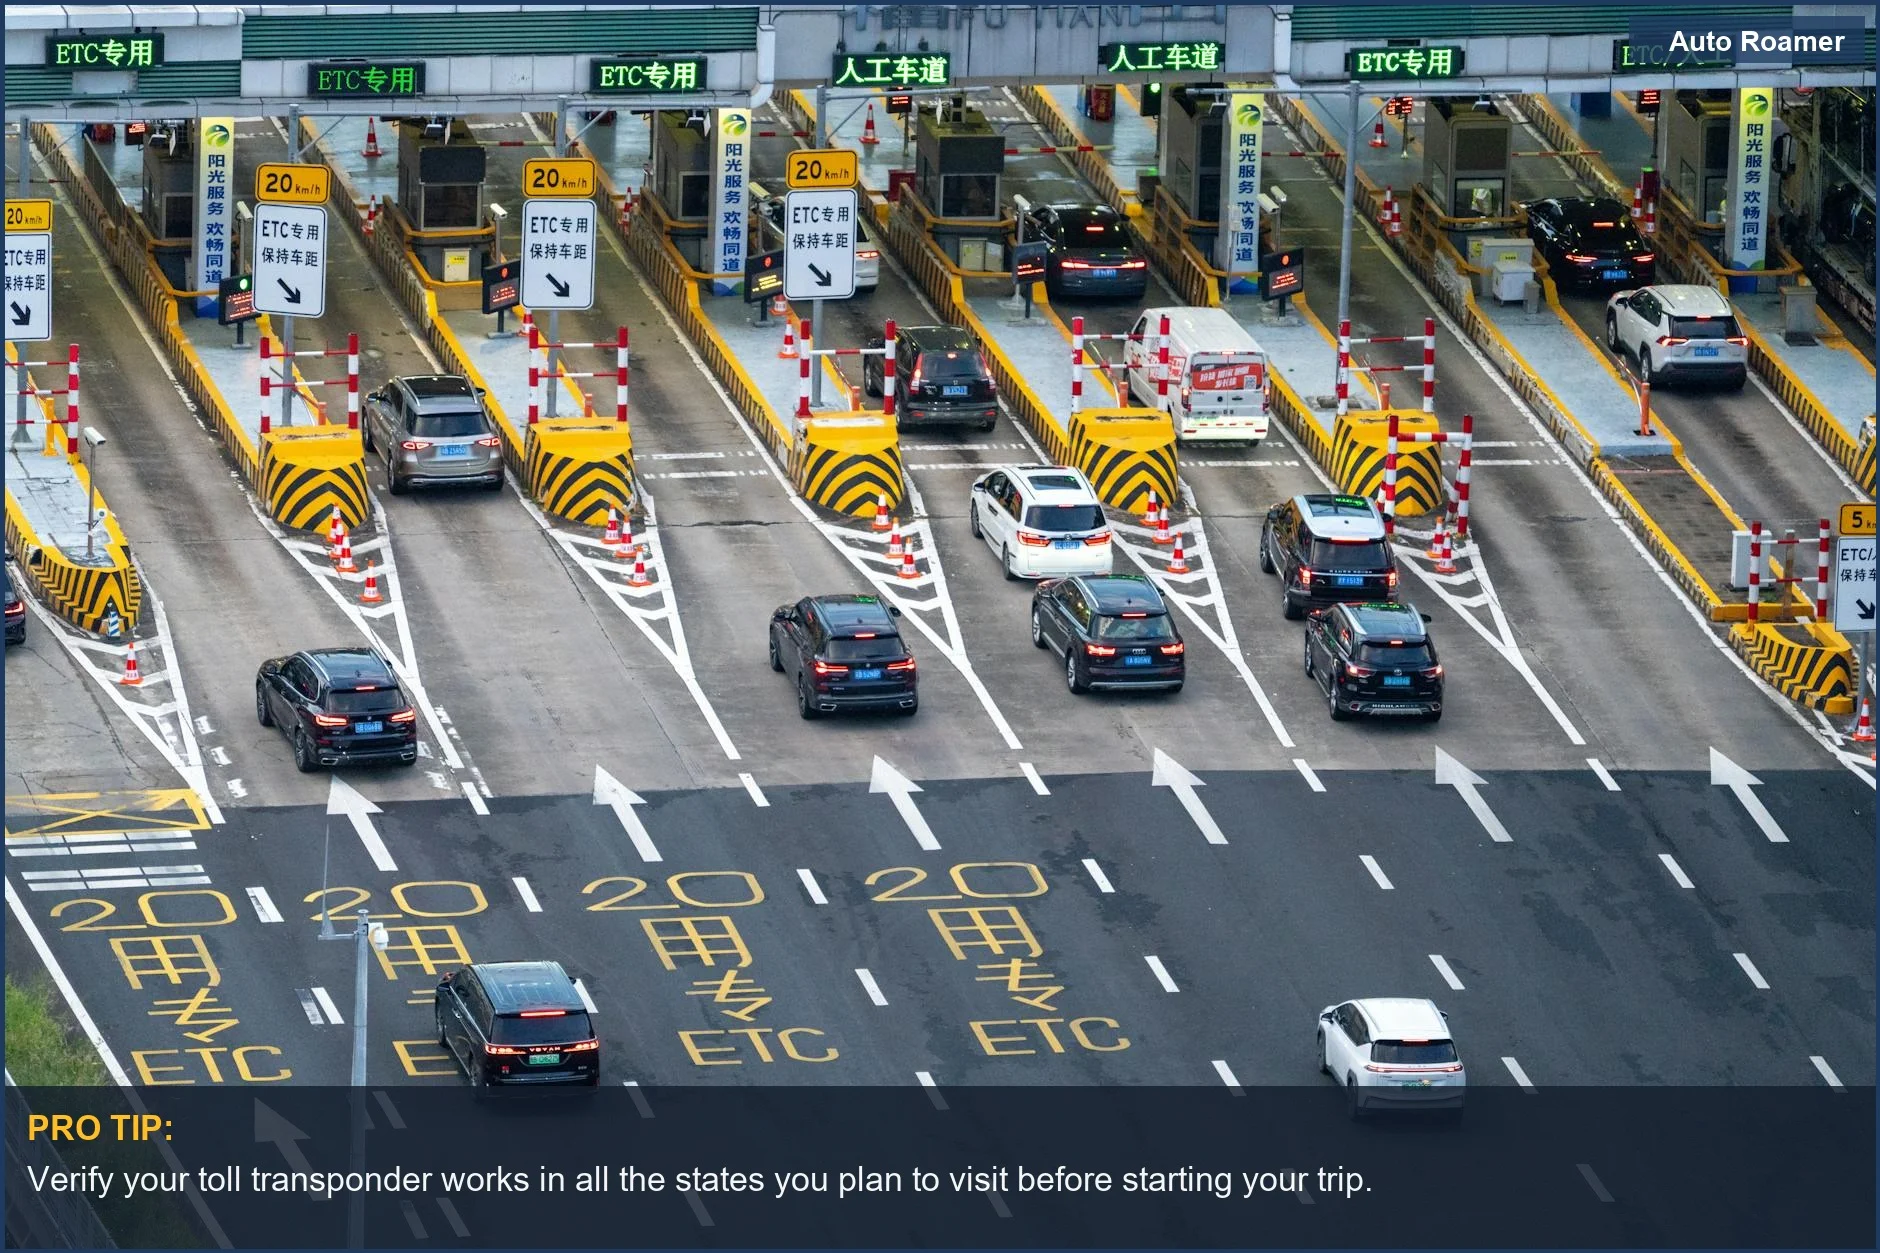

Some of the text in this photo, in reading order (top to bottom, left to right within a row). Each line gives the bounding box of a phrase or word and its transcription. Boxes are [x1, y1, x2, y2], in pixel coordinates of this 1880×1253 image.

[55, 40, 153, 67] ETC专用
[836, 56, 948, 85] 人工车道
[1108, 43, 1219, 73] 人工车道
[1355, 47, 1453, 76] ETC专用
[317, 66, 415, 94] ETC专用
[600, 60, 697, 90] ETC专用
[532, 168, 588, 189] 20 km/h
[795, 159, 850, 181] 20 km/h
[1238, 133, 1257, 195] 阳光服务
[265, 173, 321, 195] 20 km/h
[1740, 123, 1764, 252] 阳光服务 欢畅同道
[7, 207, 43, 225] 20 km/h
[205, 154, 226, 285] 阳光服务 欢畅同道
[531, 216, 588, 234] ETC专用
[721, 143, 743, 273] 阳光服务 欢畅同道
[793, 206, 849, 224] ETC专用
[262, 220, 319, 241] ETC专用
[793, 232, 849, 249] 保持车距
[261, 247, 318, 267] 保持车距
[530, 243, 587, 260] 保持车距
[1851, 510, 1863, 529] 5
[582, 871, 764, 911] 20
[866, 863, 1048, 901] 20
[50, 890, 238, 931] 20
[303, 881, 488, 922] 20
[641, 915, 753, 973] 用
[928, 906, 1042, 963] 用
[109, 934, 221, 993] 用
[685, 969, 772, 1021] 专
[974, 957, 1064, 1011] 专
[147, 987, 239, 1043] 专
[678, 1027, 839, 1066] ETC
[969, 1017, 1131, 1056] ETC
[131, 1045, 292, 1086] ETC
